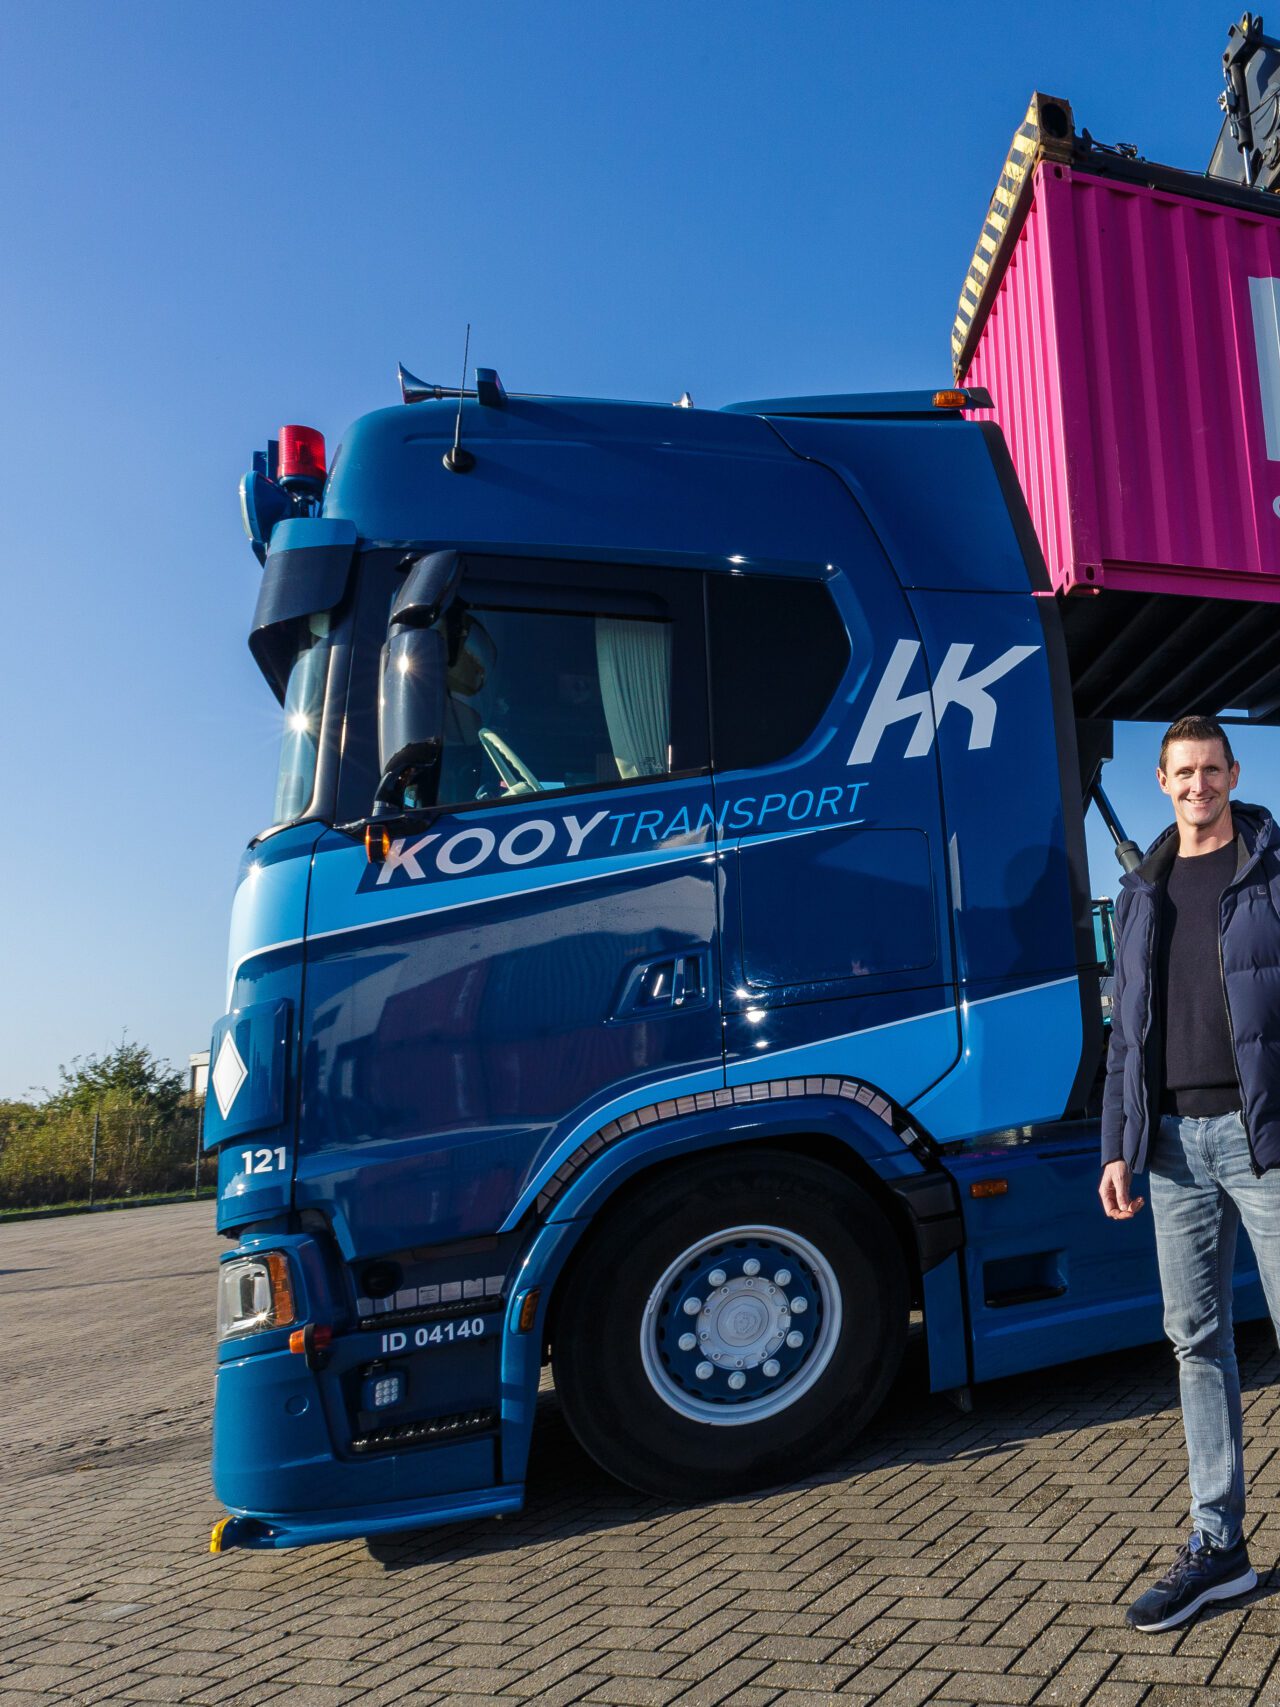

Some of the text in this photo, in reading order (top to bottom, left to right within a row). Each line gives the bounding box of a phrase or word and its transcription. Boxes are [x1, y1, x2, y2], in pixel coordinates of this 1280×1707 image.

[847, 639, 1041, 766] HK
[376, 782, 869, 886] KOOY TRANSPORT
[241, 1146, 286, 1175] 121
[382, 1317, 485, 1353] ID 04140
